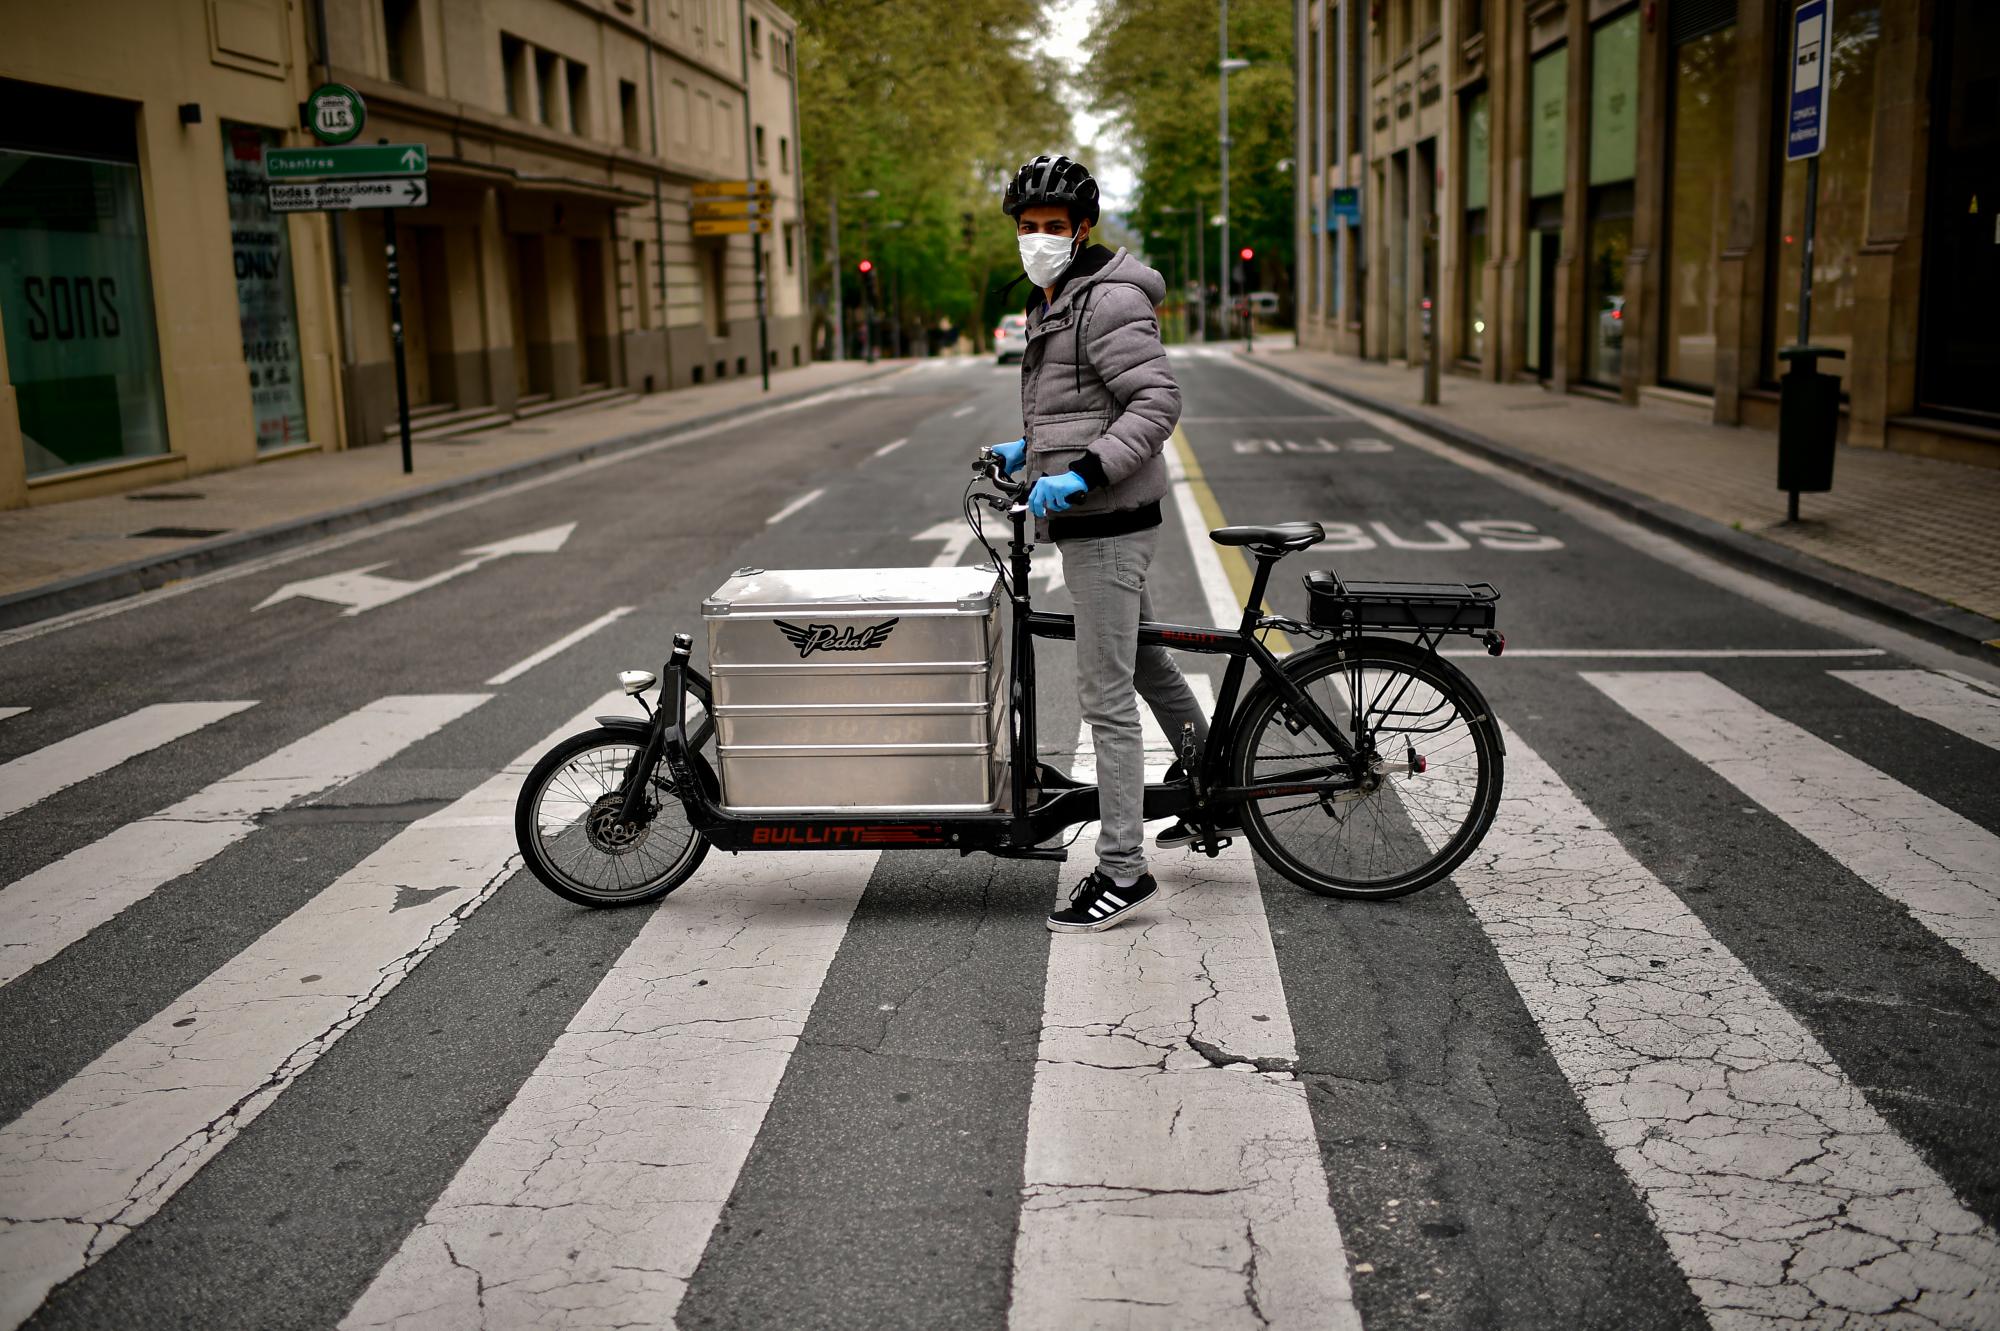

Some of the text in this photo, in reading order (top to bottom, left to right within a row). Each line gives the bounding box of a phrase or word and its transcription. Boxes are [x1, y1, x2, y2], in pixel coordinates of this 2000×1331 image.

[272, 182, 392, 199] todas direcciones
[233, 251, 282, 280] ONLY
[1306, 519, 1565, 552] BUS
[802, 626, 874, 656] Pedal
[752, 826, 865, 845] BULLITT
